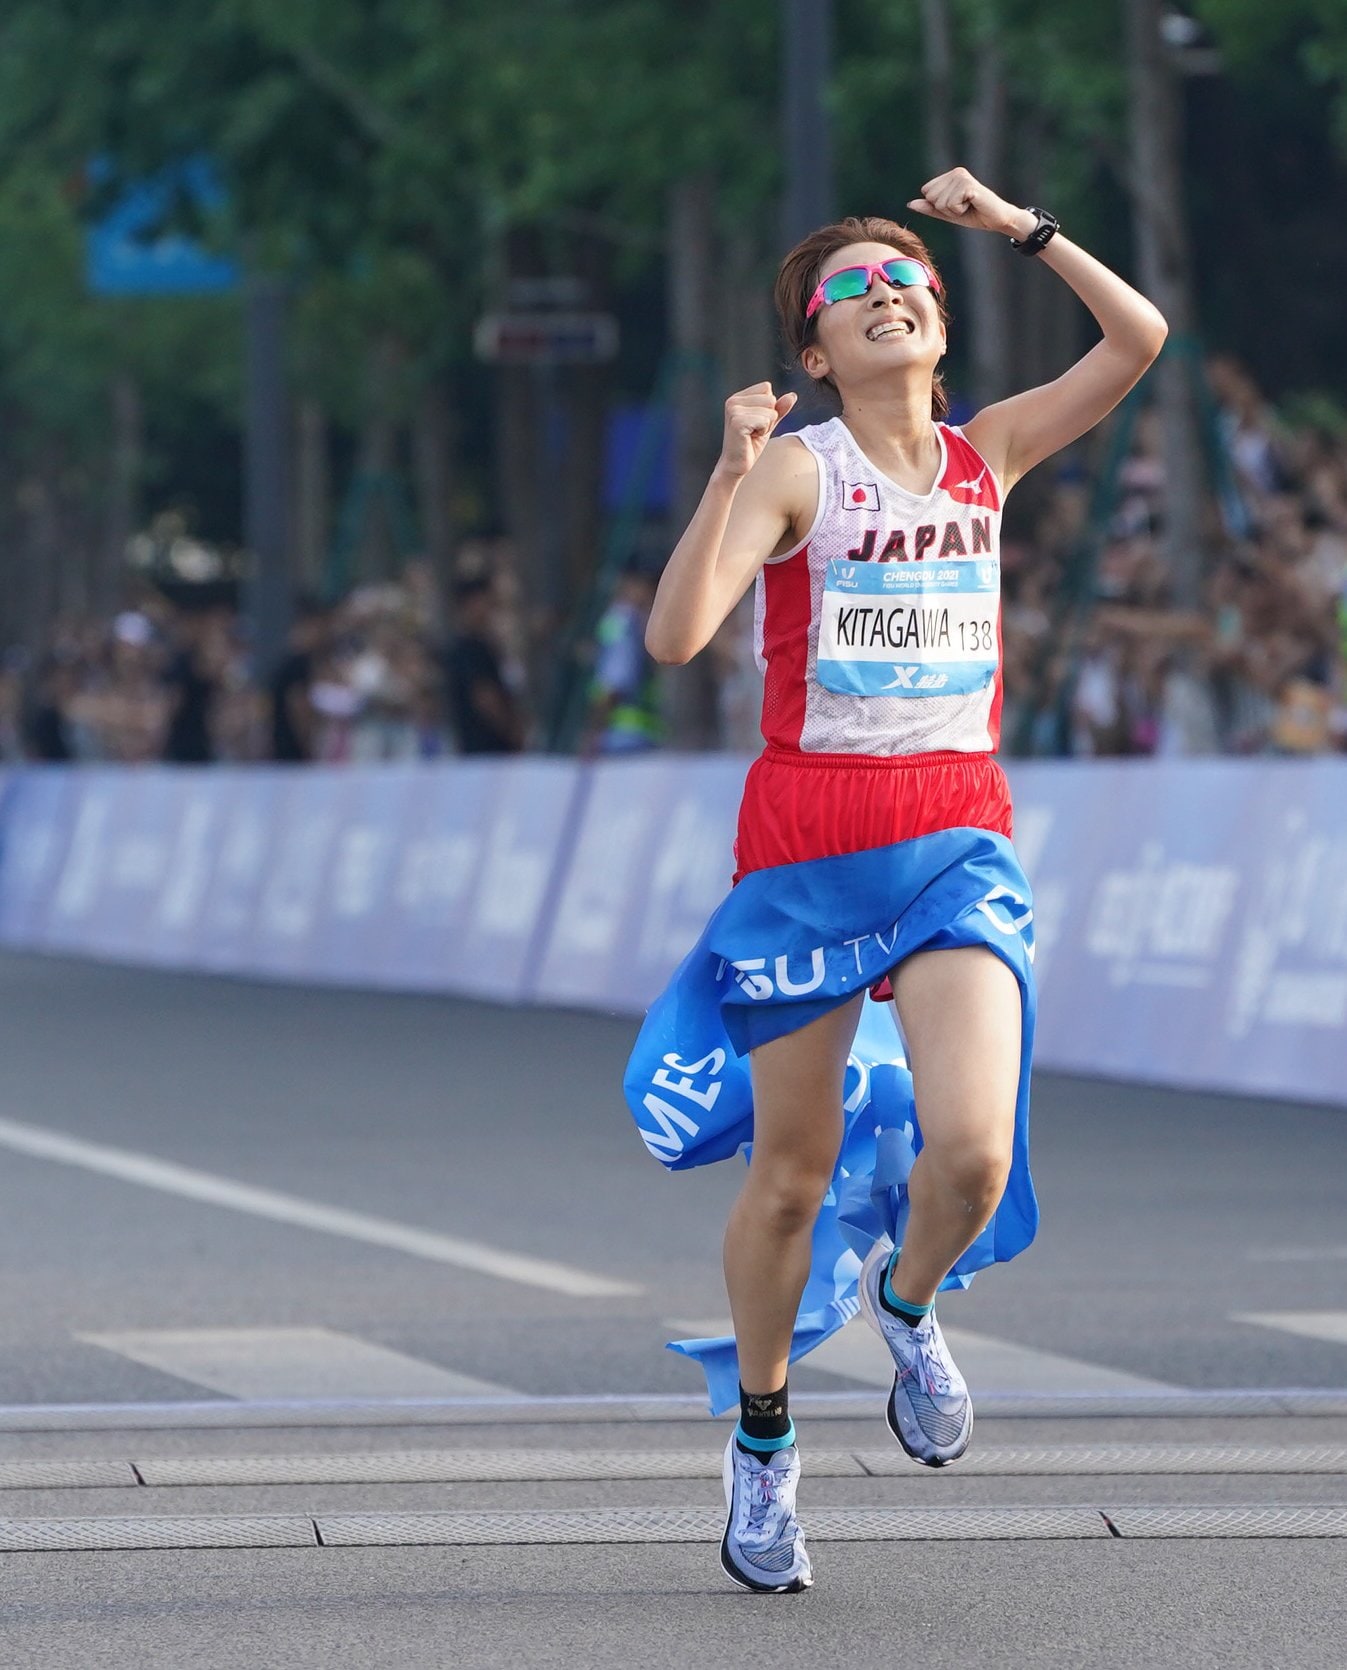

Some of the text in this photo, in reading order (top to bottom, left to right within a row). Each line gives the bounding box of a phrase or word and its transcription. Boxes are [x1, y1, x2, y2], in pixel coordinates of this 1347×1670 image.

[847, 516, 992, 562] JAPAN
[883, 569, 960, 582] CHENGDU 2021
[837, 607, 951, 648] KITAGAWA
[958, 620, 993, 652] 138
